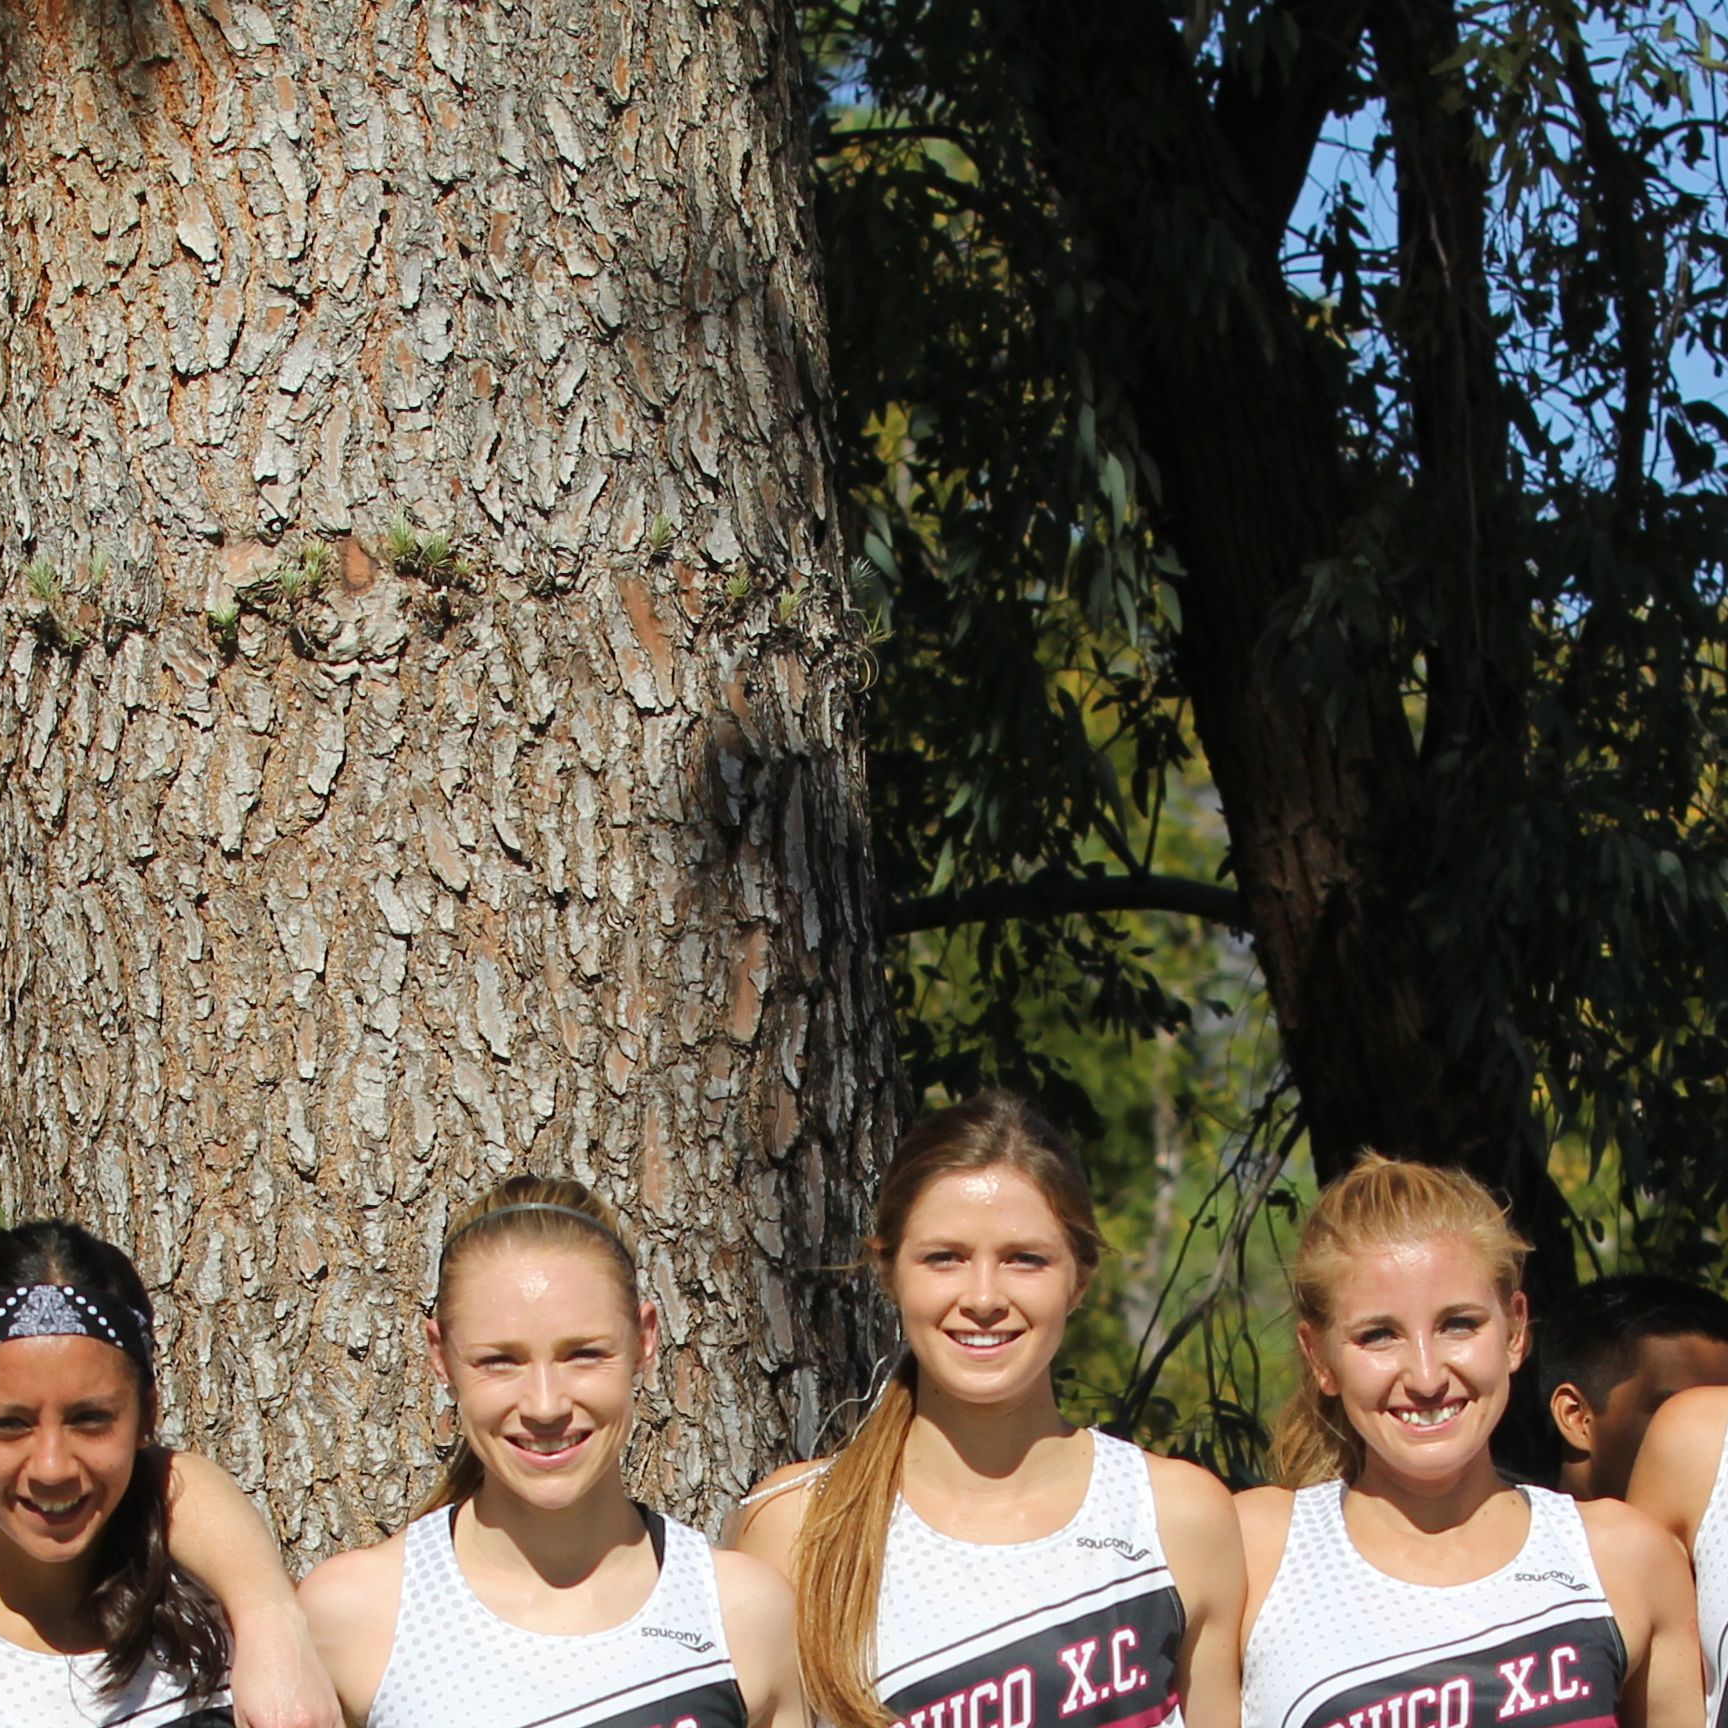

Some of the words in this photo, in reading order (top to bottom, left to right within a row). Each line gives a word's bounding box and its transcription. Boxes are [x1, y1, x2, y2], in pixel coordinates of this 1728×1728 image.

[1076, 1537, 1134, 1556] saucony
[1514, 1571, 1575, 1585] saucony
[641, 1626, 702, 1646] saucony
[1061, 1629, 1147, 1714] X.C.
[1497, 1648, 1590, 1718] X.C.
